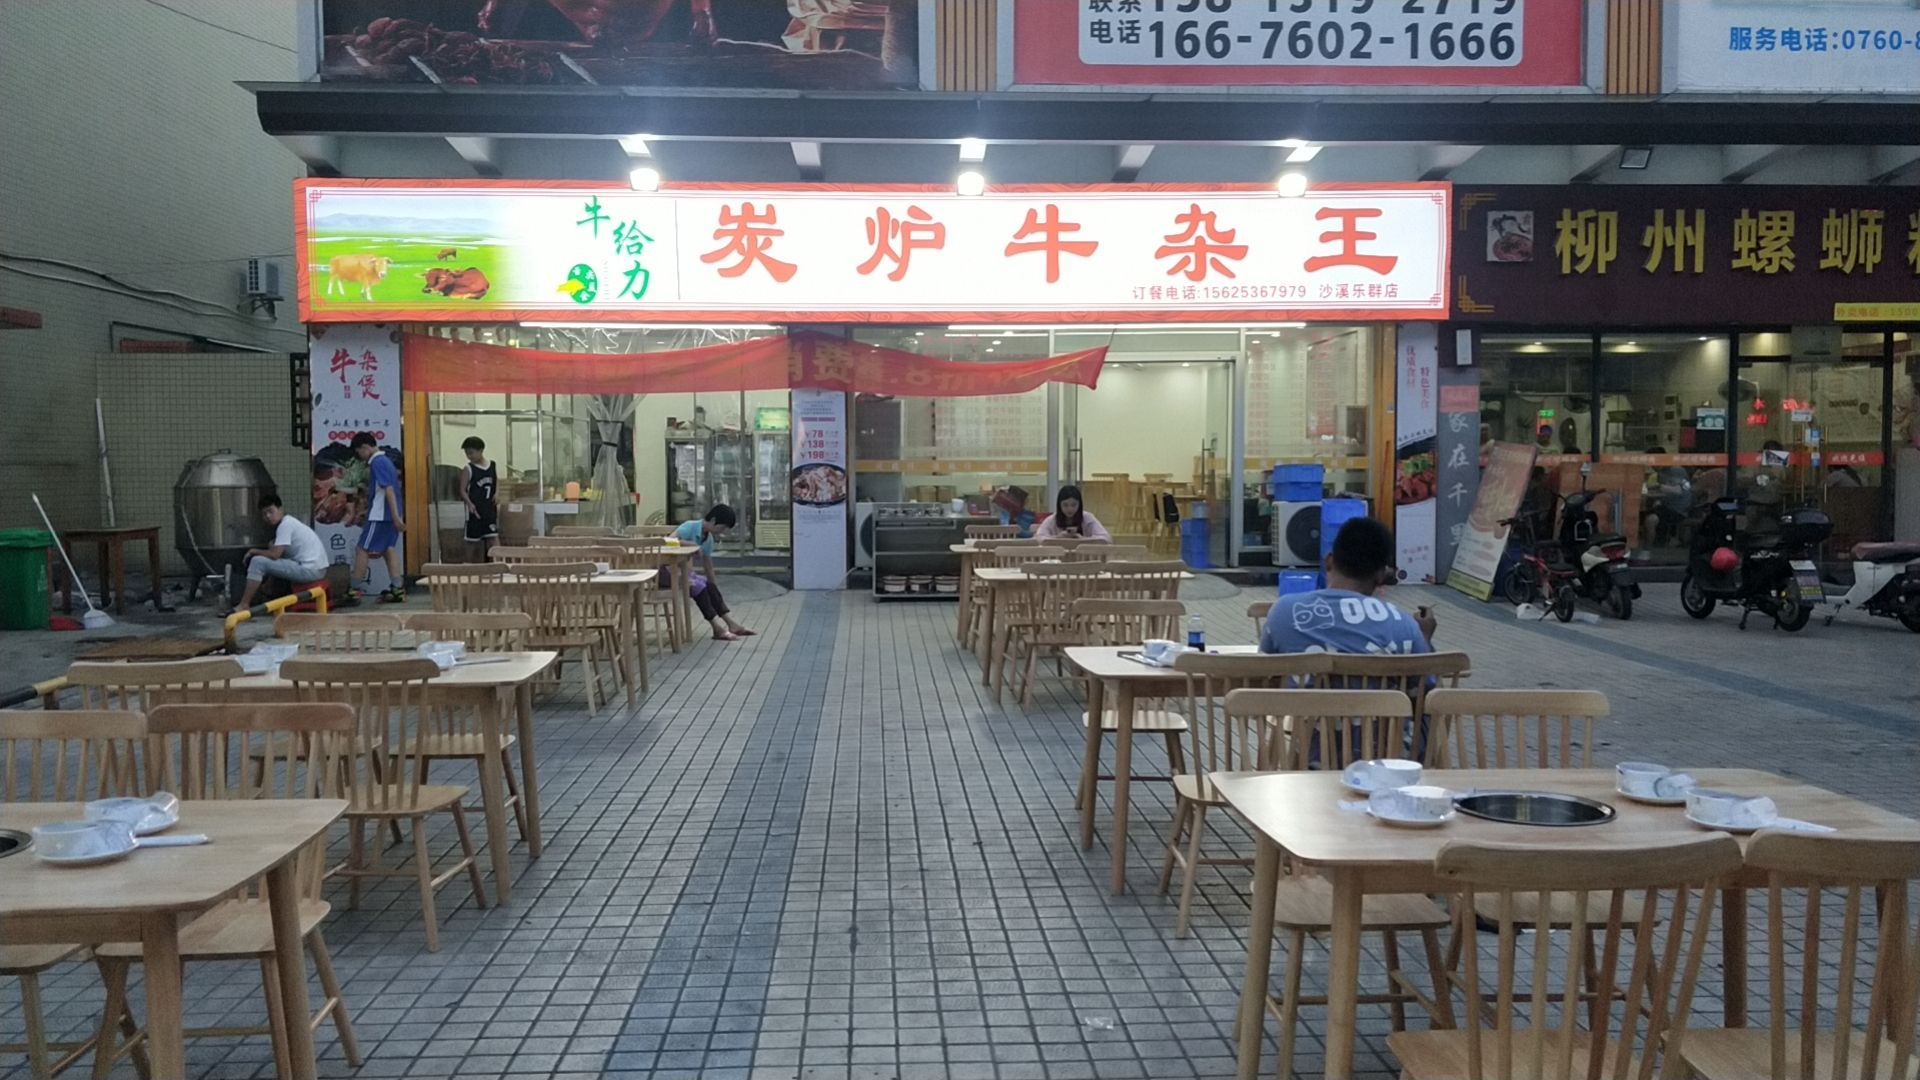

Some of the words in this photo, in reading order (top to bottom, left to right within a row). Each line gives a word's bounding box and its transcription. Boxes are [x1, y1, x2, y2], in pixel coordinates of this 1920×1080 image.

[1090, 19, 1142, 45] 电话
[1148, 20, 1516, 60] 166-7602-1666
[576, 195, 654, 302] 牛给力
[699, 201, 1399, 284] 炭炉牛杂王
[1554, 207, 1920, 275] 柳州螺蛳
[1132, 284, 1308, 301] 订餐电话:15625367979
[1318, 282, 1400, 299] 沙溪乐群店
